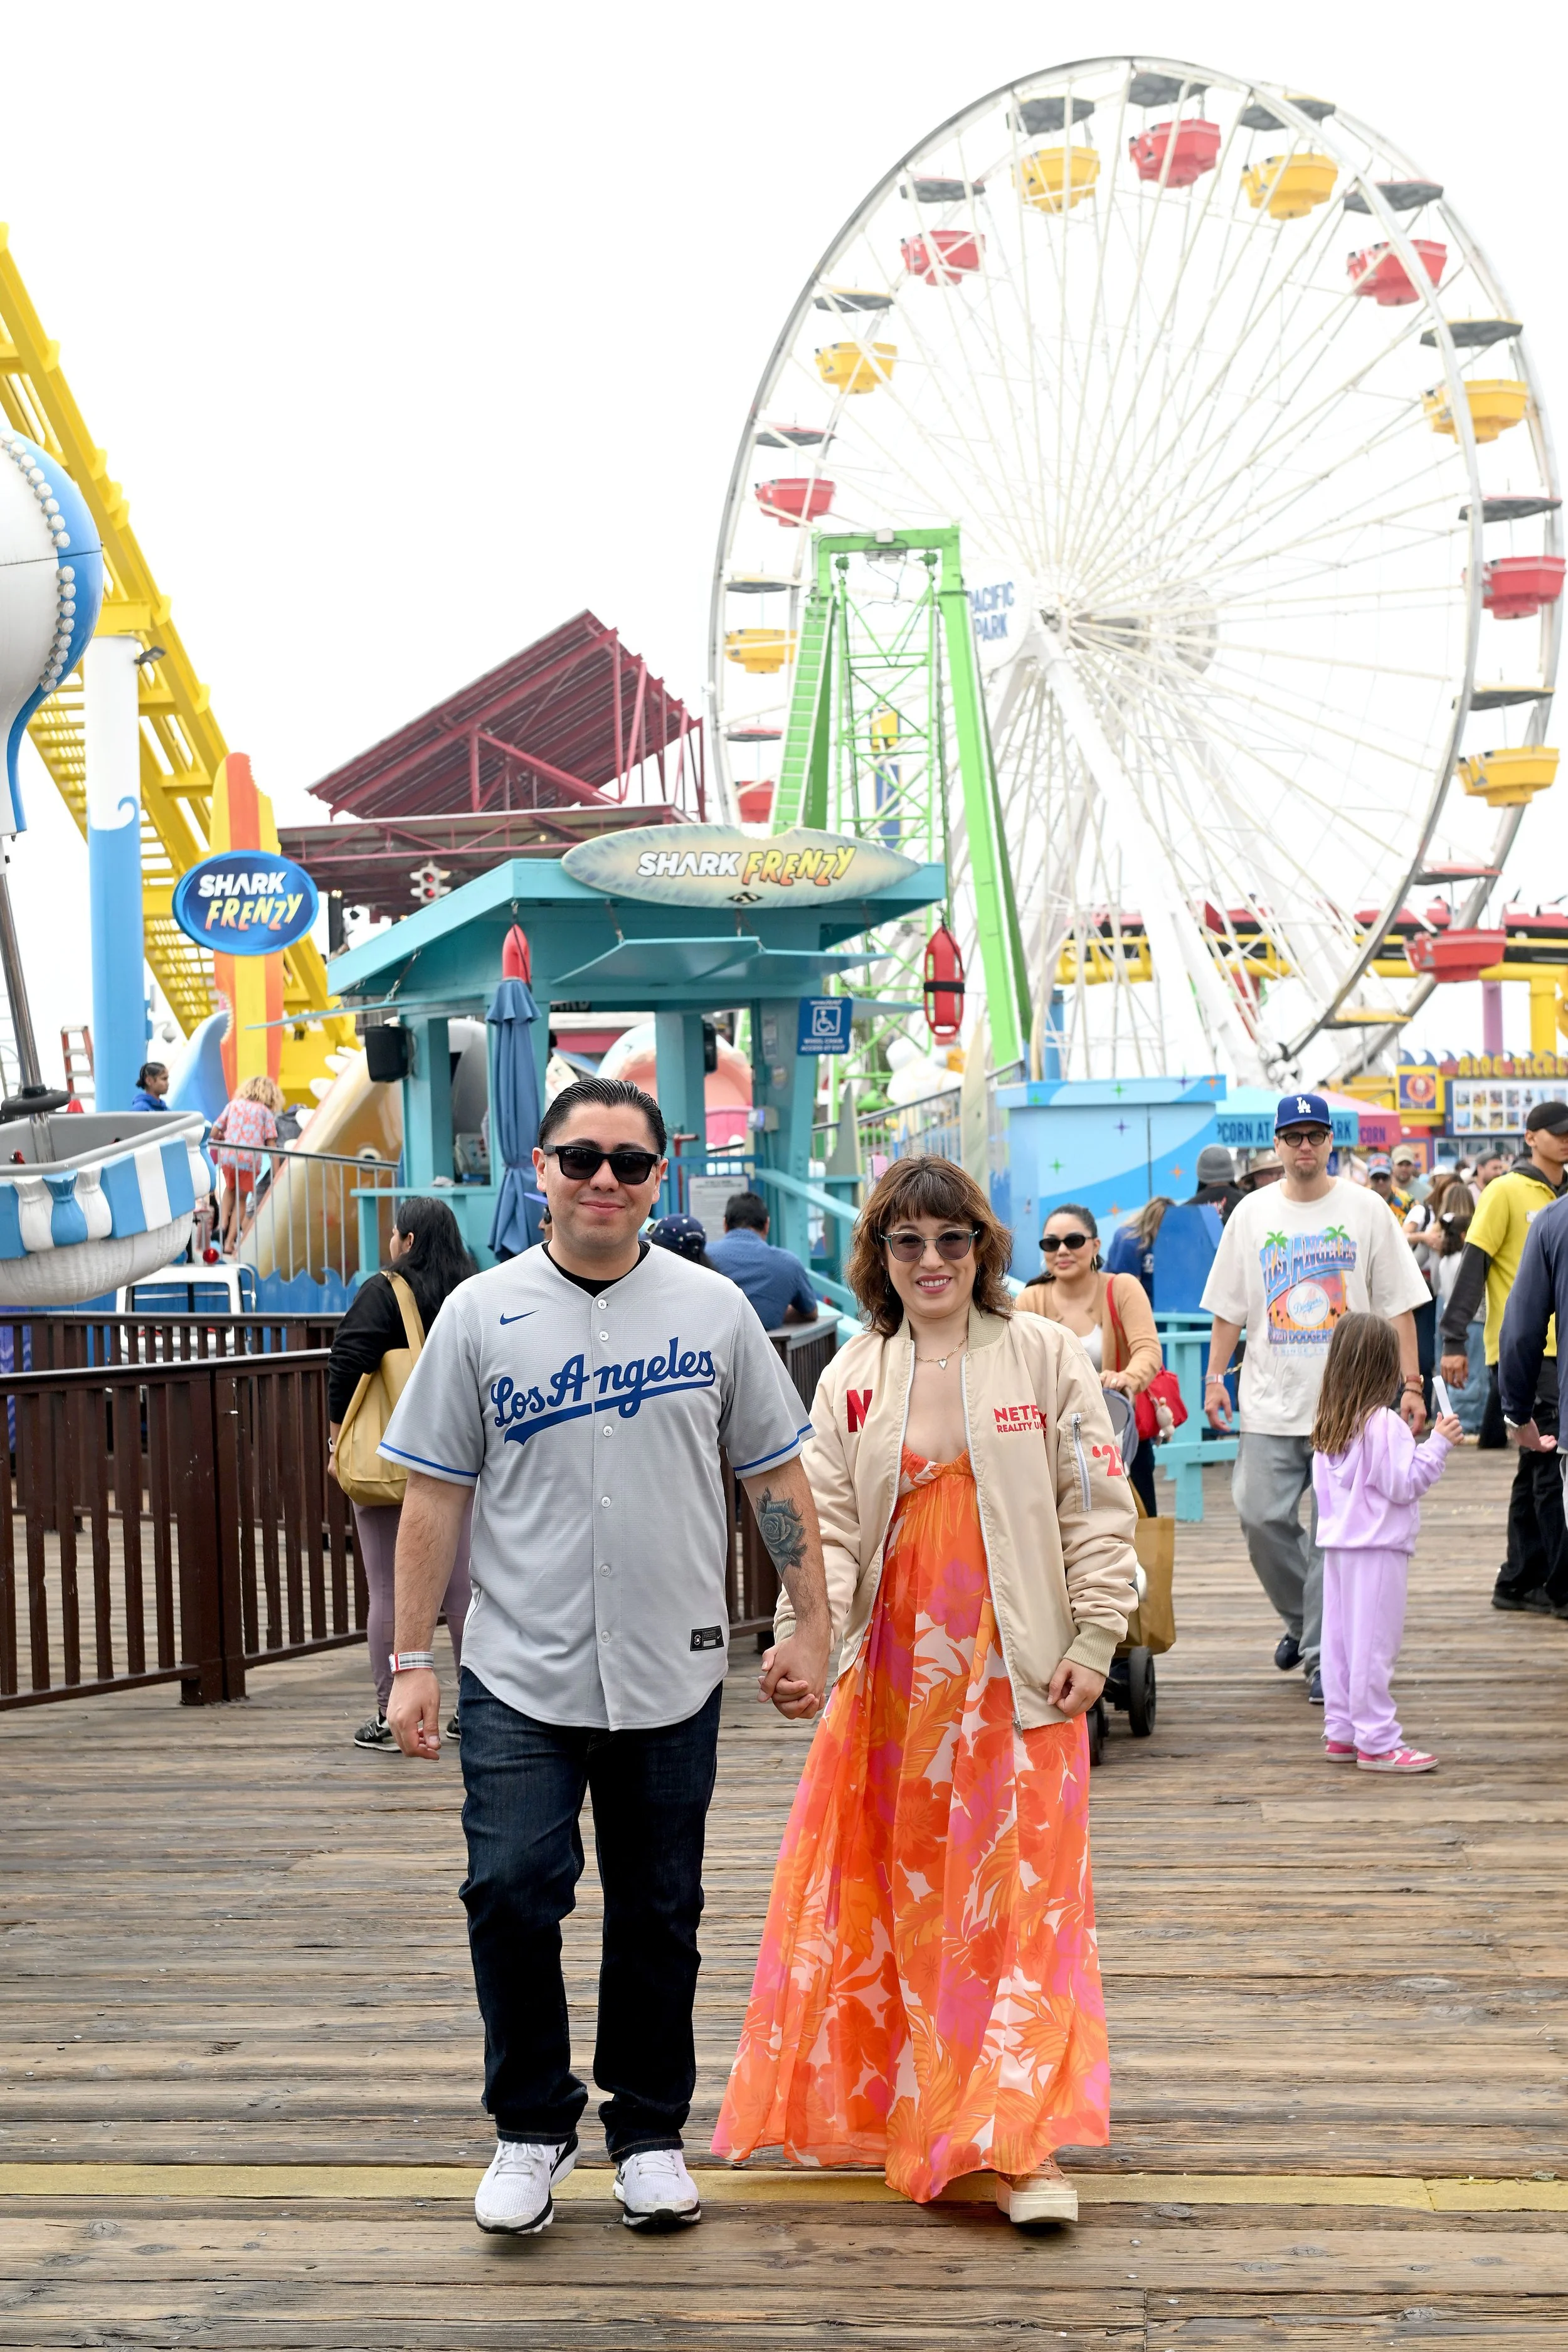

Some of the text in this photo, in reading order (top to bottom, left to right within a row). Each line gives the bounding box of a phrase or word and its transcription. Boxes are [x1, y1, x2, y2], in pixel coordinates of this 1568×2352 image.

[637, 845, 857, 886] SHARK FRENZY
[198, 872, 287, 898] SHARK
[204, 893, 304, 931] FRENZY
[1296, 1096, 1311, 1114] LA
[1257, 1120, 1271, 1143] AT
[1293, 1296, 1324, 1315] Dodgers
[490, 1337, 716, 1428] Los Angeles
[993, 1404, 1047, 1429] NETFX
[997, 1421, 1032, 1433] REALITY
